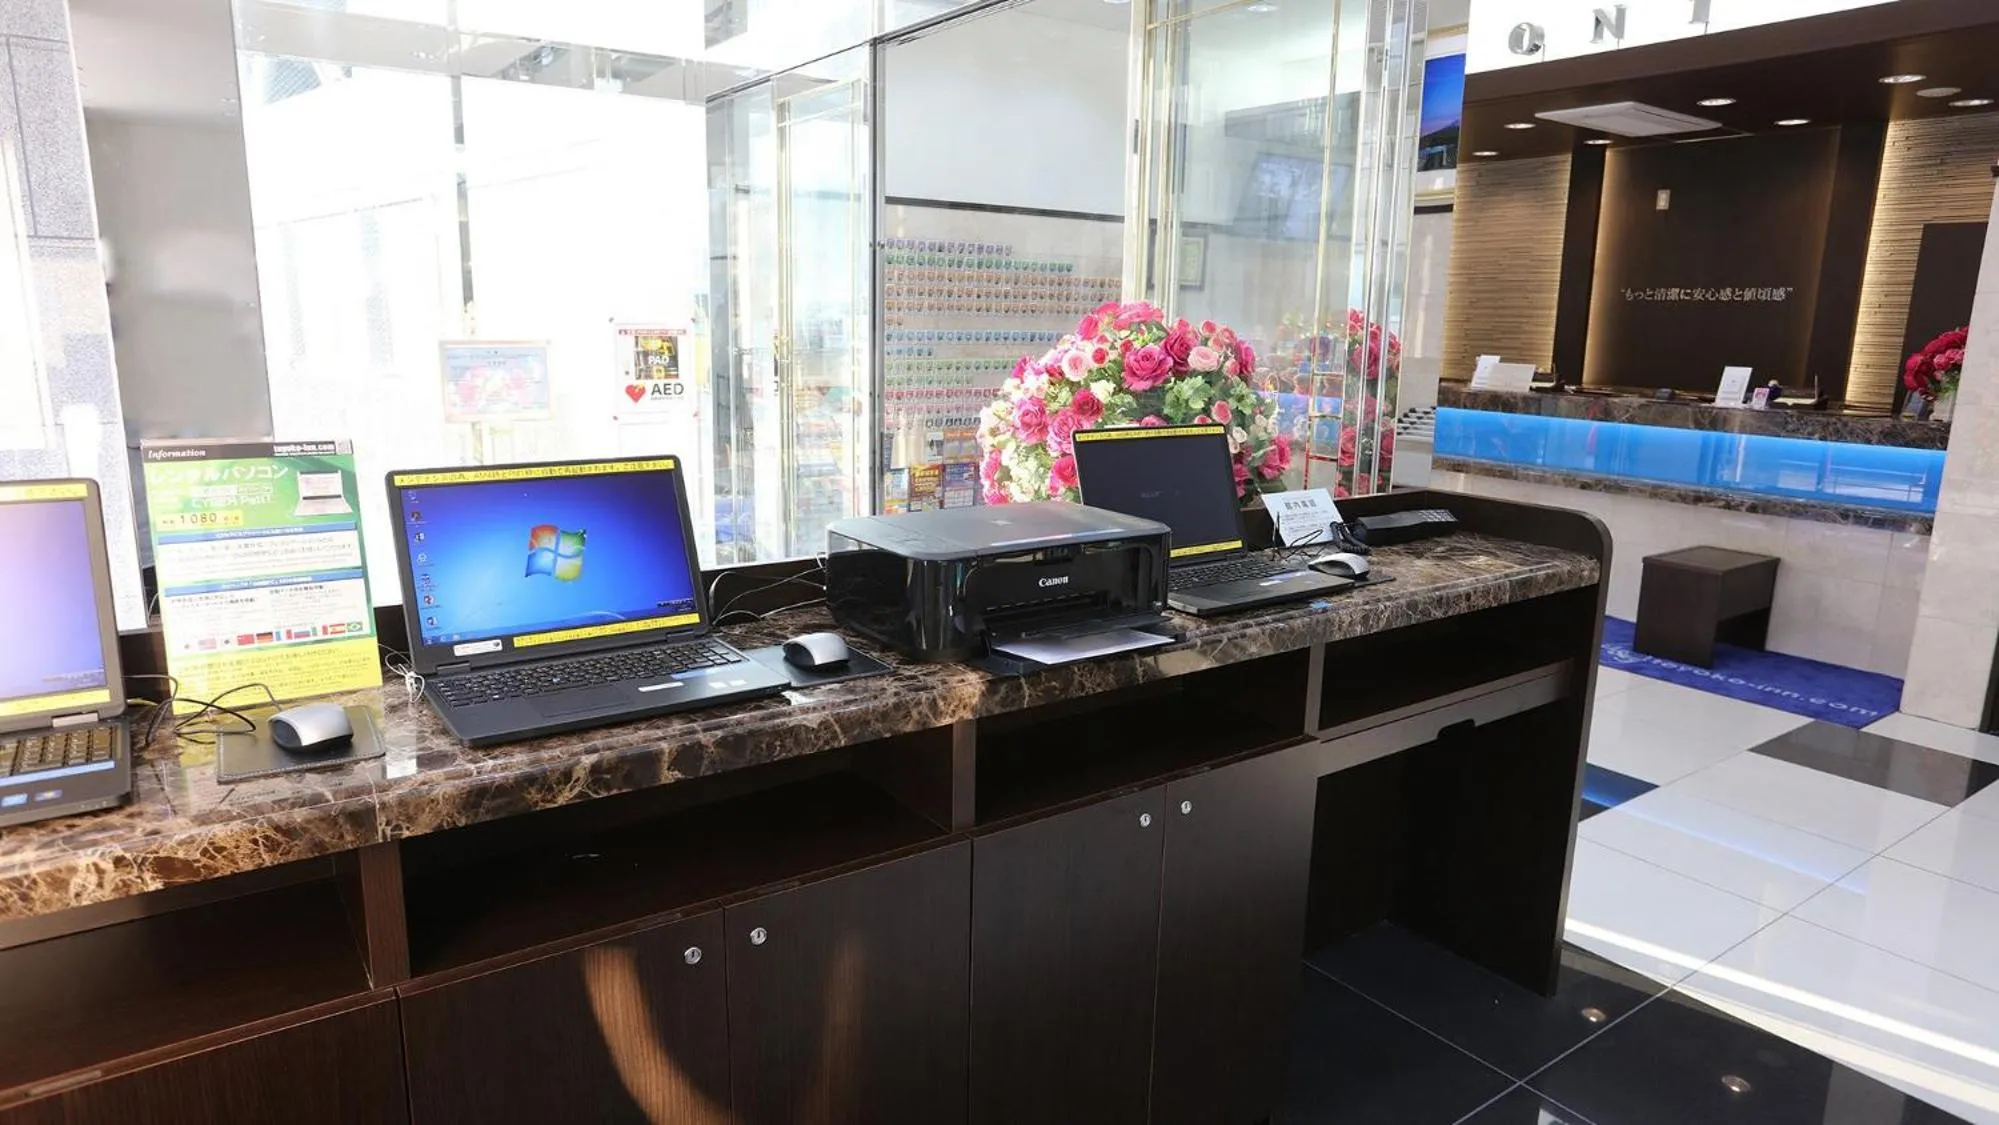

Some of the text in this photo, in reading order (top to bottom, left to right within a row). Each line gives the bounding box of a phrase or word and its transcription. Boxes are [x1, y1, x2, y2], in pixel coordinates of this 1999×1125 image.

[650, 382, 685, 396] AED
[148, 448, 206, 460] Information
[1038, 575, 1069, 588] Canon
